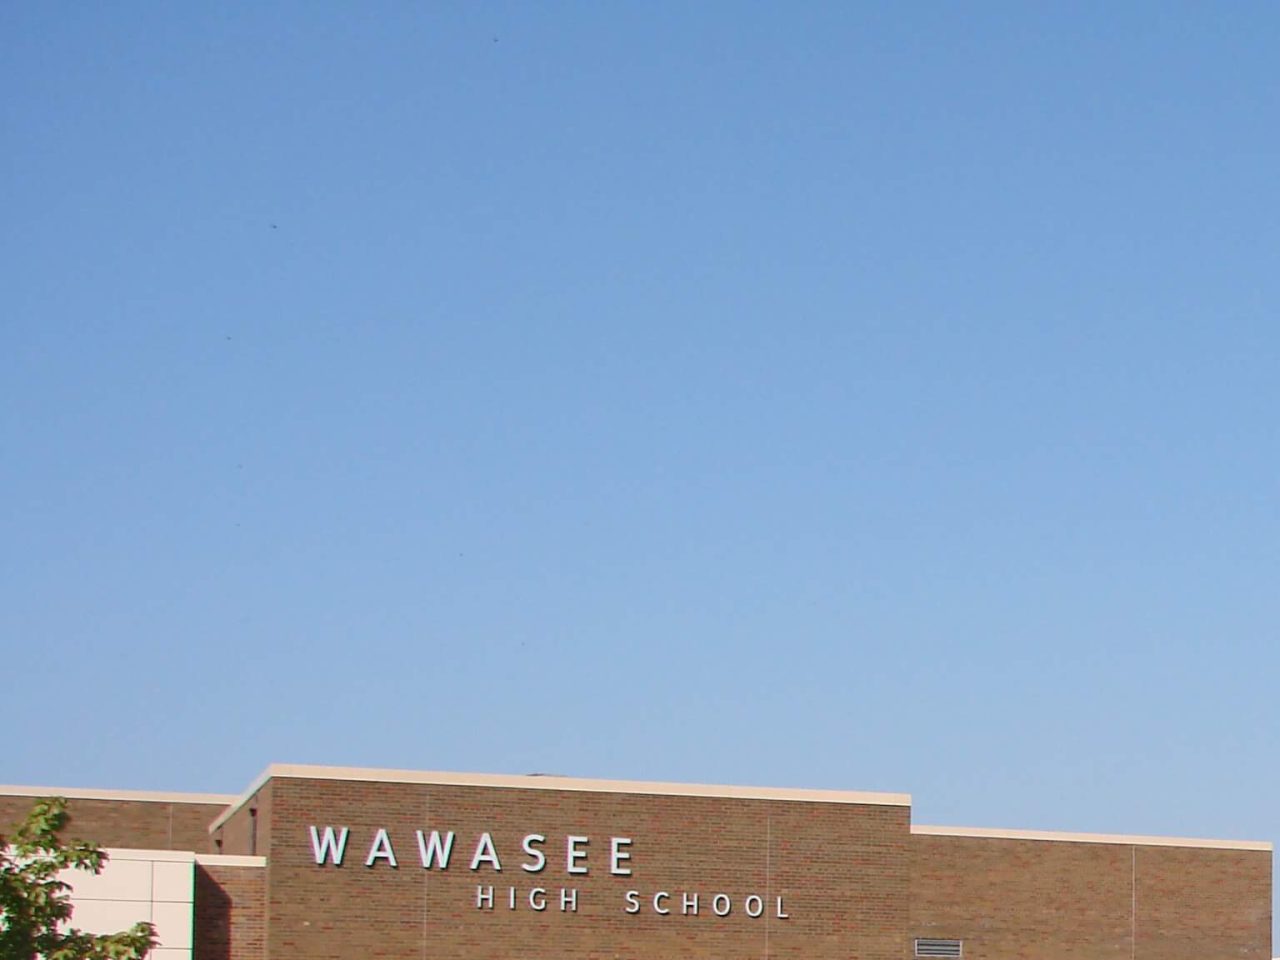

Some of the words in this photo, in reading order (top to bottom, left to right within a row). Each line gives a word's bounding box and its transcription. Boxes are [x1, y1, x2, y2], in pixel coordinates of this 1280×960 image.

[309, 826, 633, 876] WAWASEE
[476, 885, 579, 912] HIGH
[625, 890, 789, 919] SCHOOL
